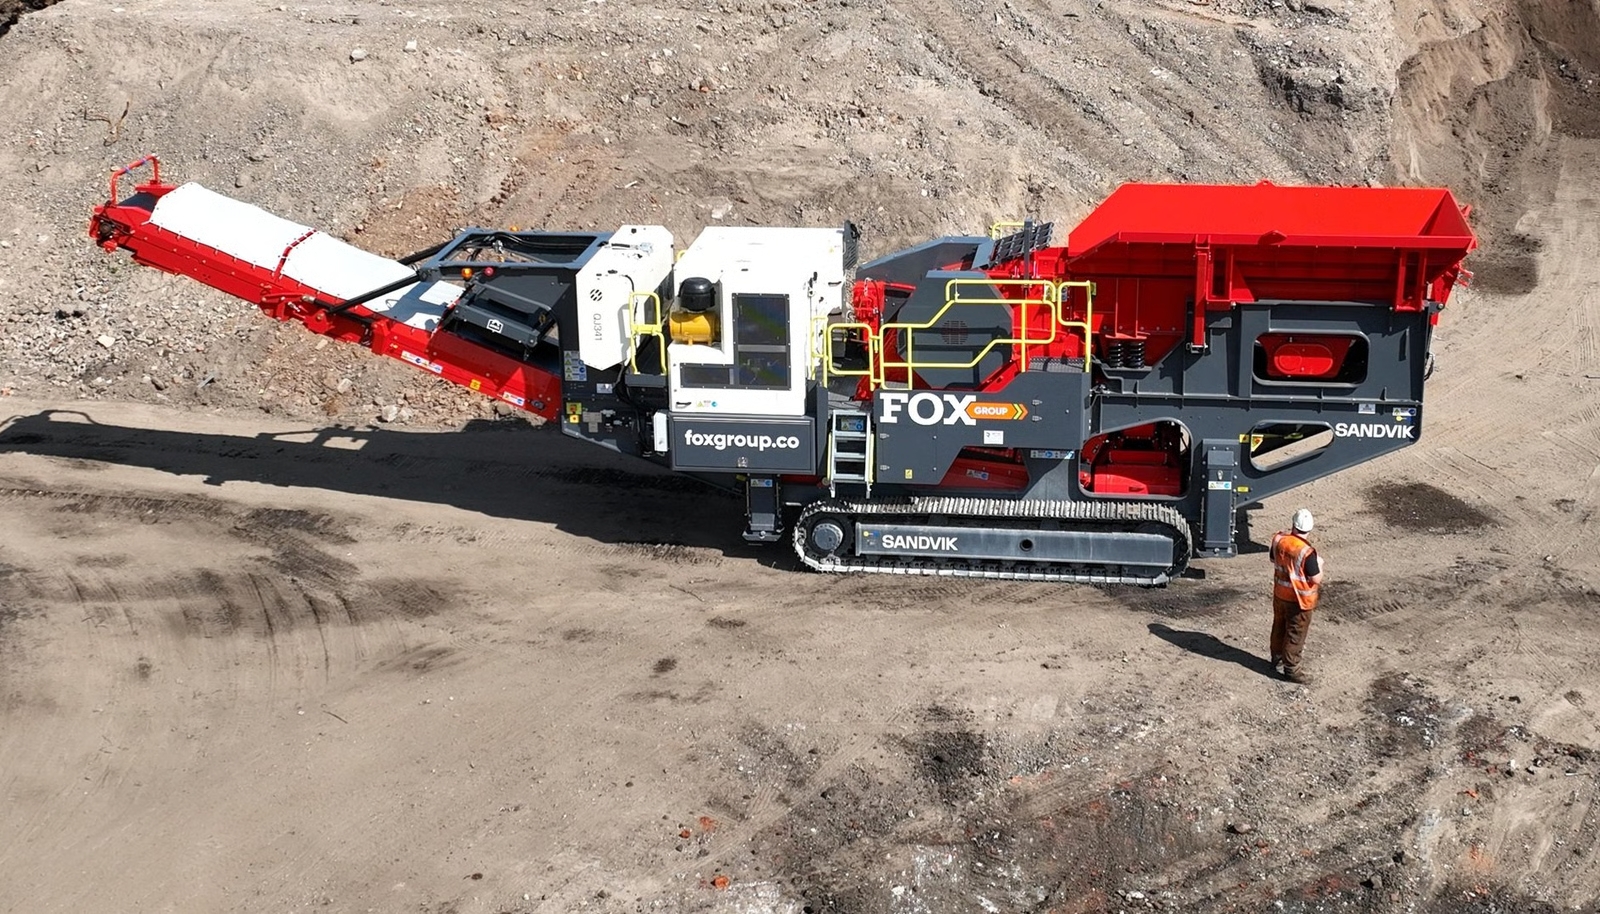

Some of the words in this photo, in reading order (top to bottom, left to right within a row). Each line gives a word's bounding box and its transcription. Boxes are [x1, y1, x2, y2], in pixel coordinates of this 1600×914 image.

[593, 313, 602, 341] QJ341
[879, 392, 977, 426] FOX
[974, 406, 1008, 415] GROUP
[685, 429, 800, 451] foxgroup.co
[1335, 423, 1415, 438] SANDVIK
[882, 535, 958, 551] SANDVIK
